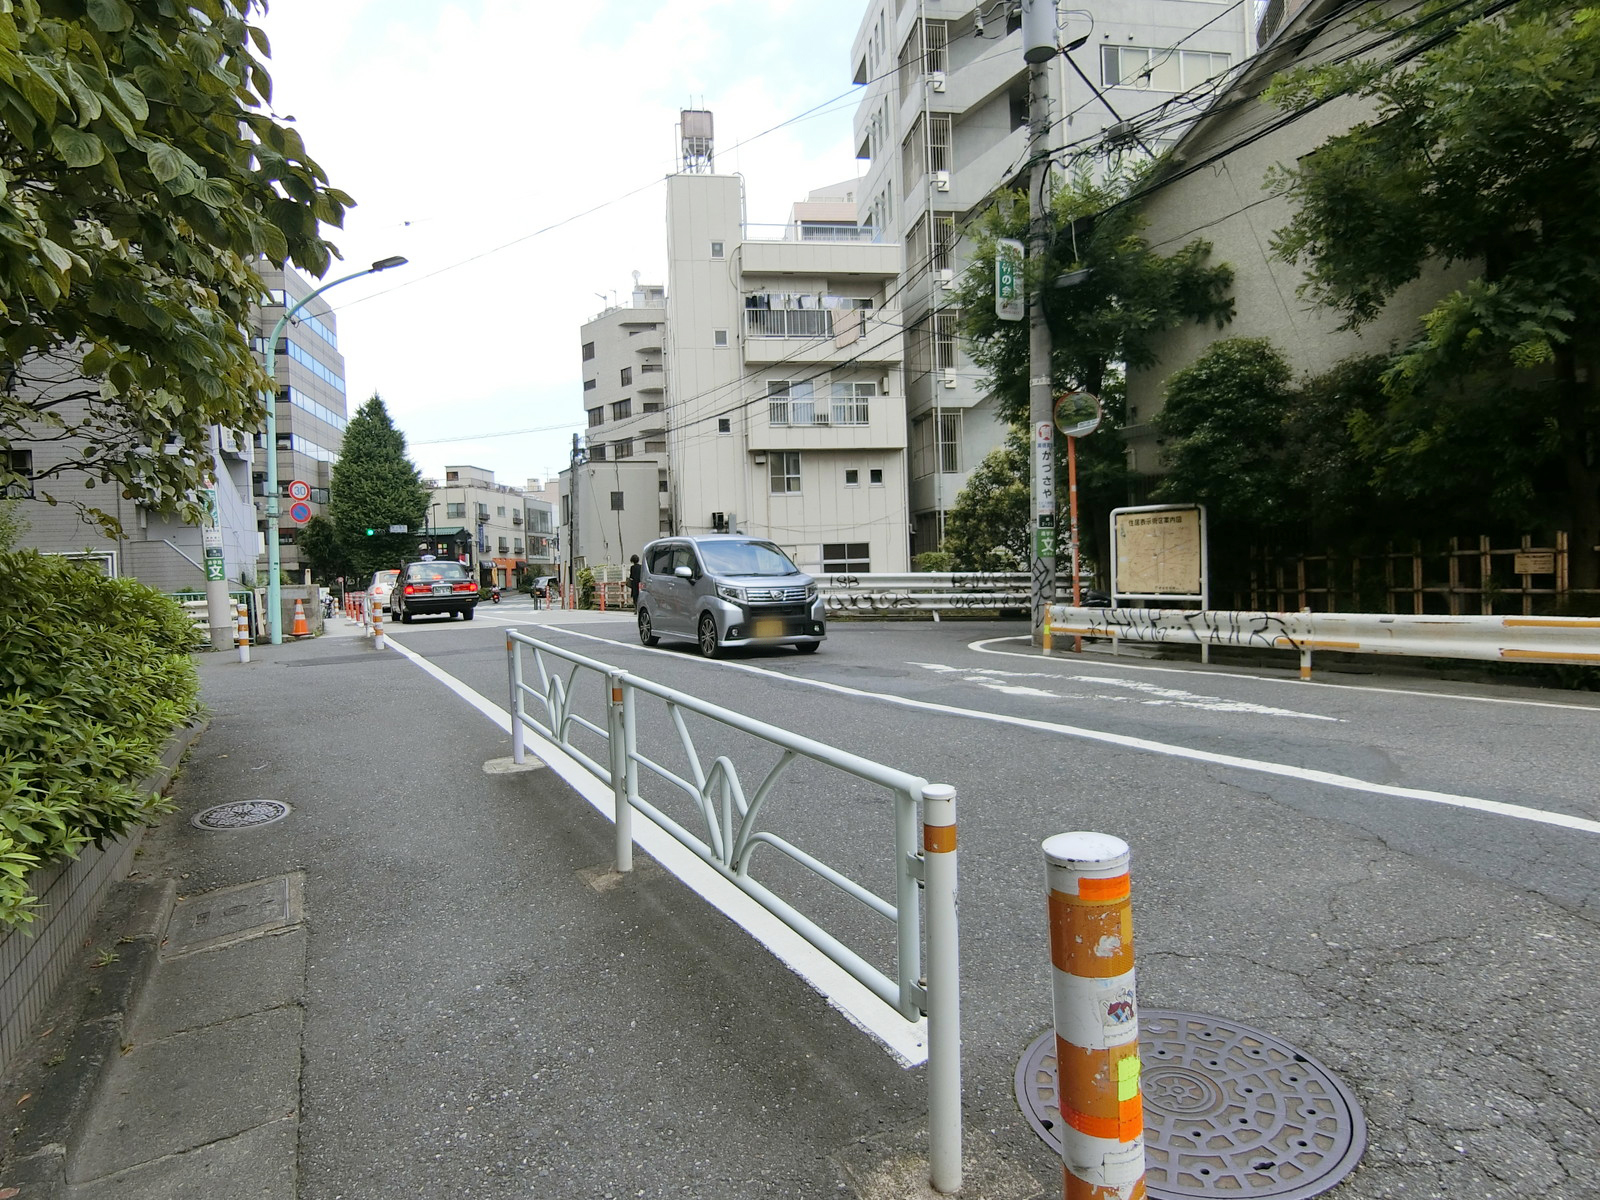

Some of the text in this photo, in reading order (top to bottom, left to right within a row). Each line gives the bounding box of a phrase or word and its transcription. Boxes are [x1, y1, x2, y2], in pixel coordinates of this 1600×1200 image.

[1042, 450, 1052, 498] かづさや
[294, 486, 306, 496] 30
[1041, 537, 1054, 552] 文
[208, 564, 223, 578] 文
